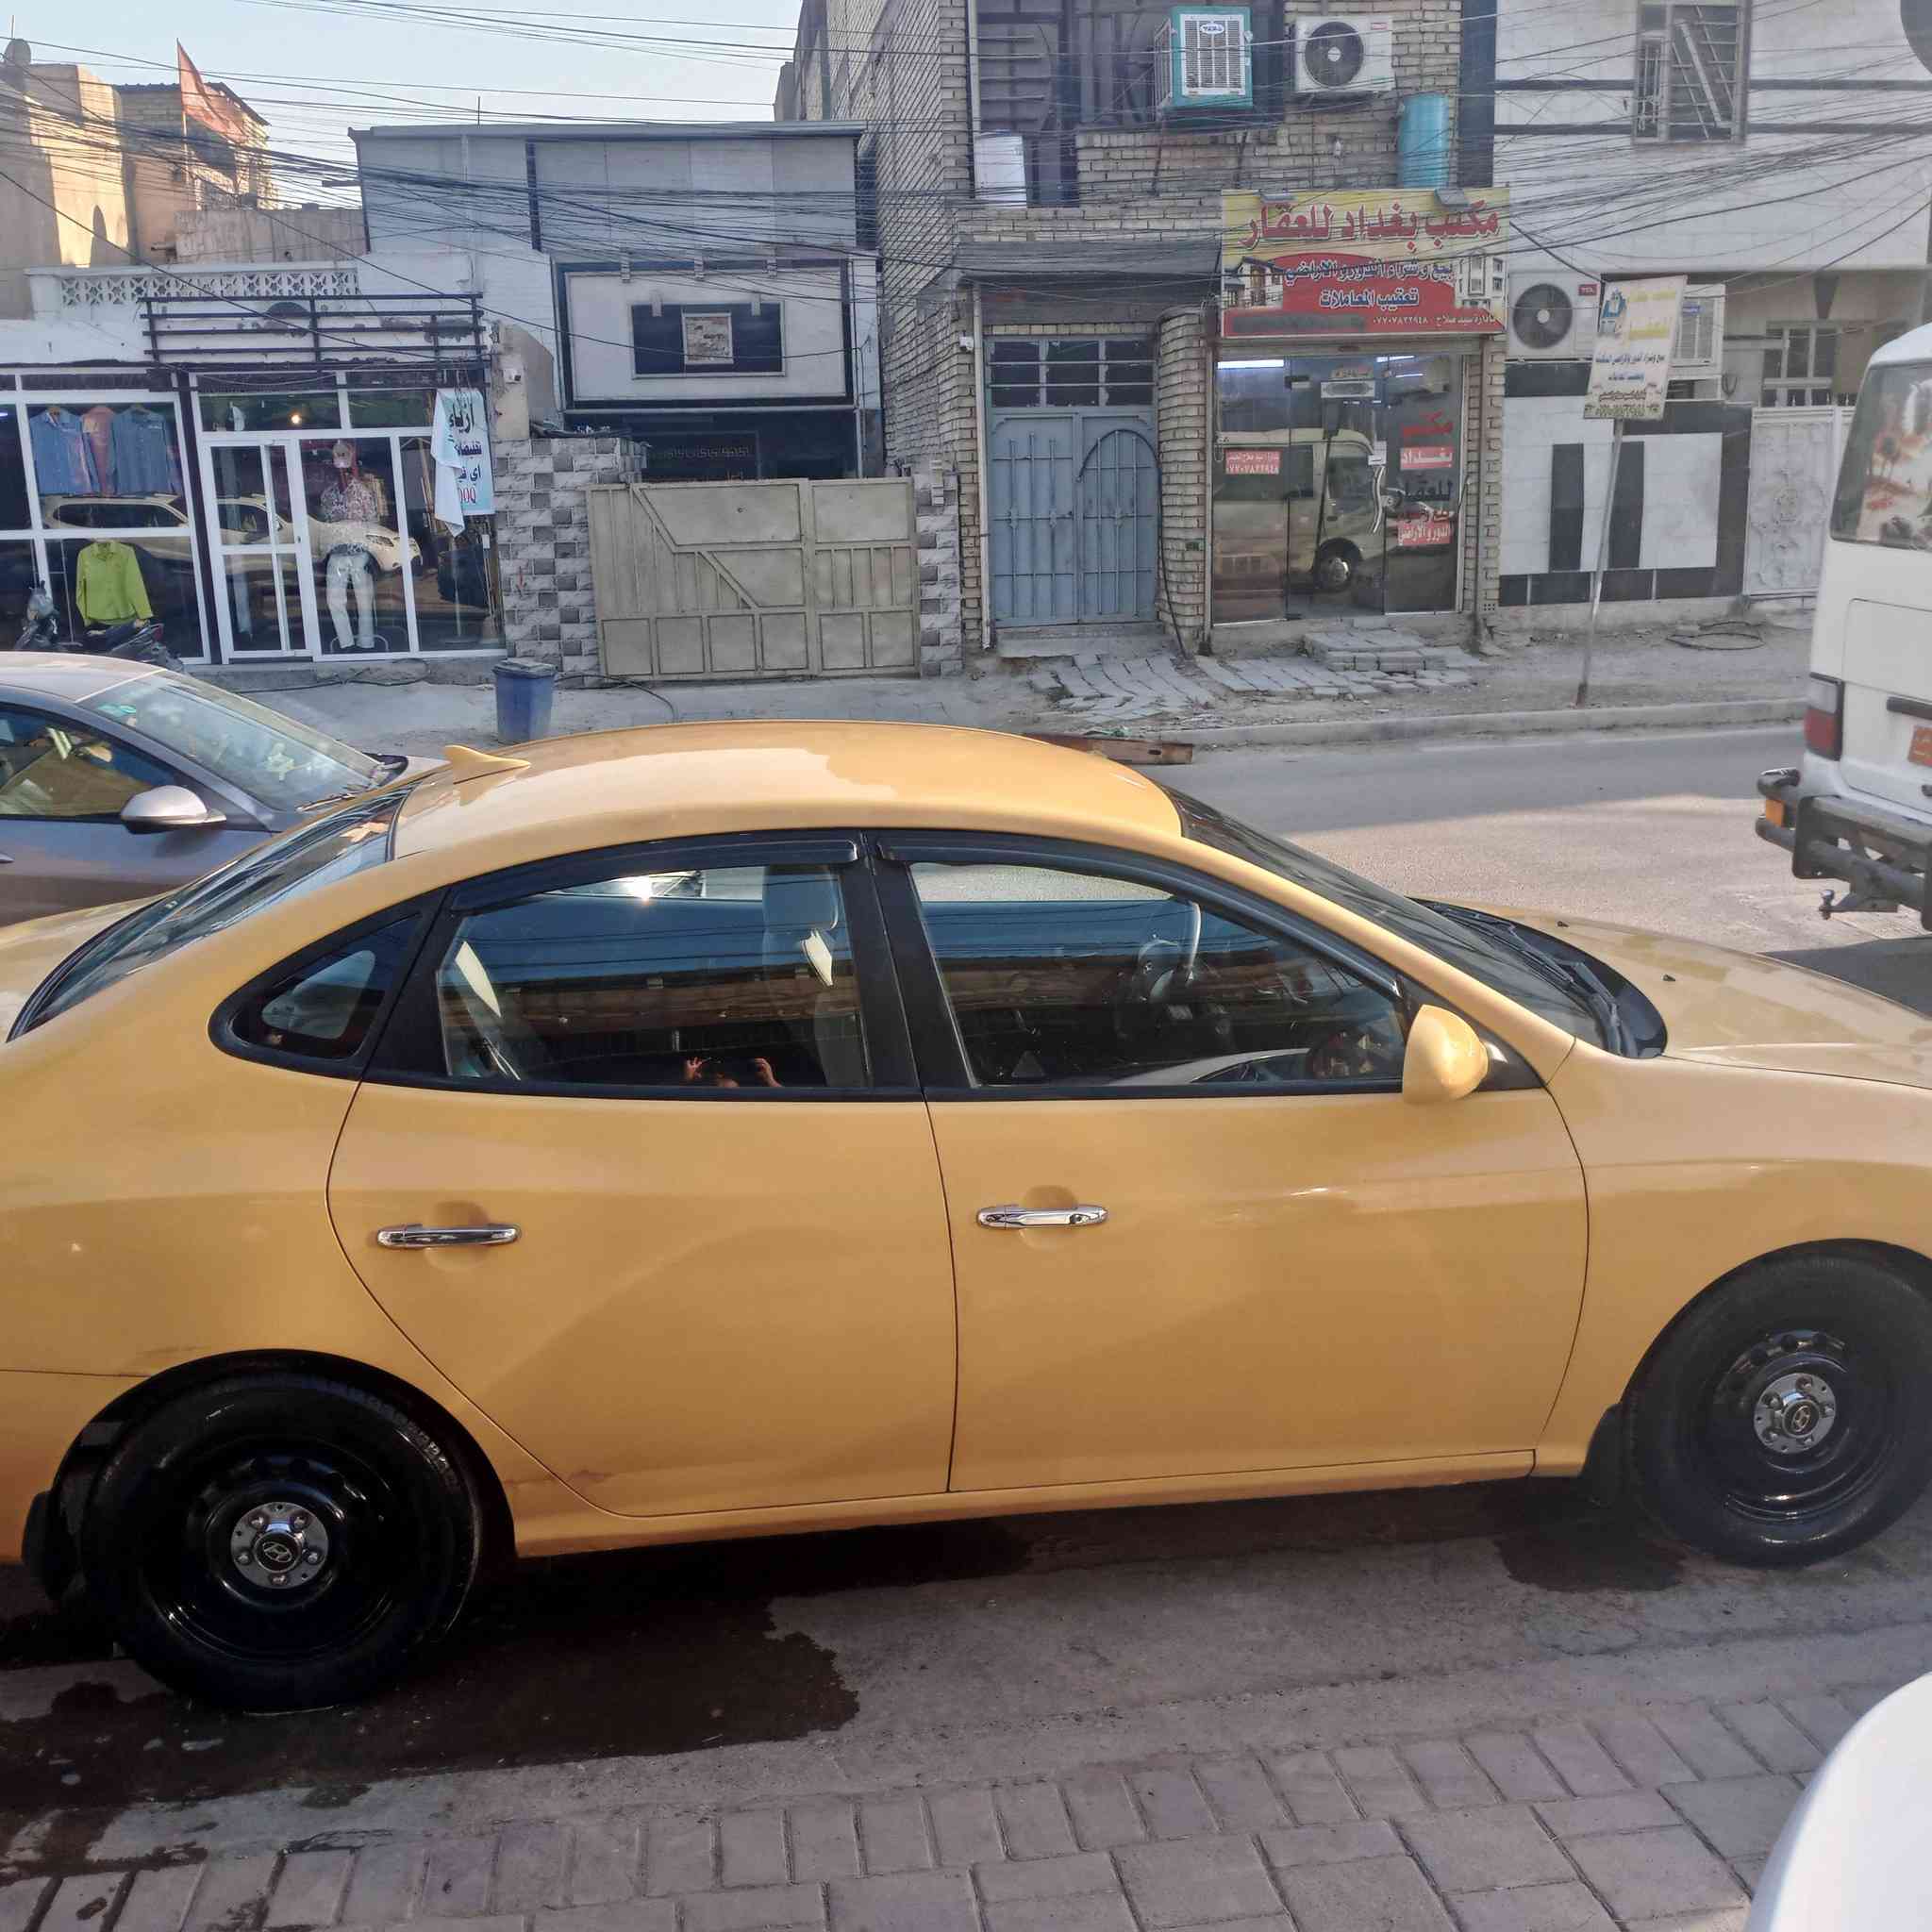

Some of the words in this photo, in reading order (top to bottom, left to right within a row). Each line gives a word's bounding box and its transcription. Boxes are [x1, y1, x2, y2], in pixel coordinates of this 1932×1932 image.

[1238, 201, 1334, 250] للعقار
[1340, 199, 1420, 252] بغداد
[1425, 199, 1500, 248] مكتب
[1319, 288, 1375, 309] المعاملات
[1375, 287, 1419, 310] تعقيب
[1403, 447, 1453, 469] بغداد
